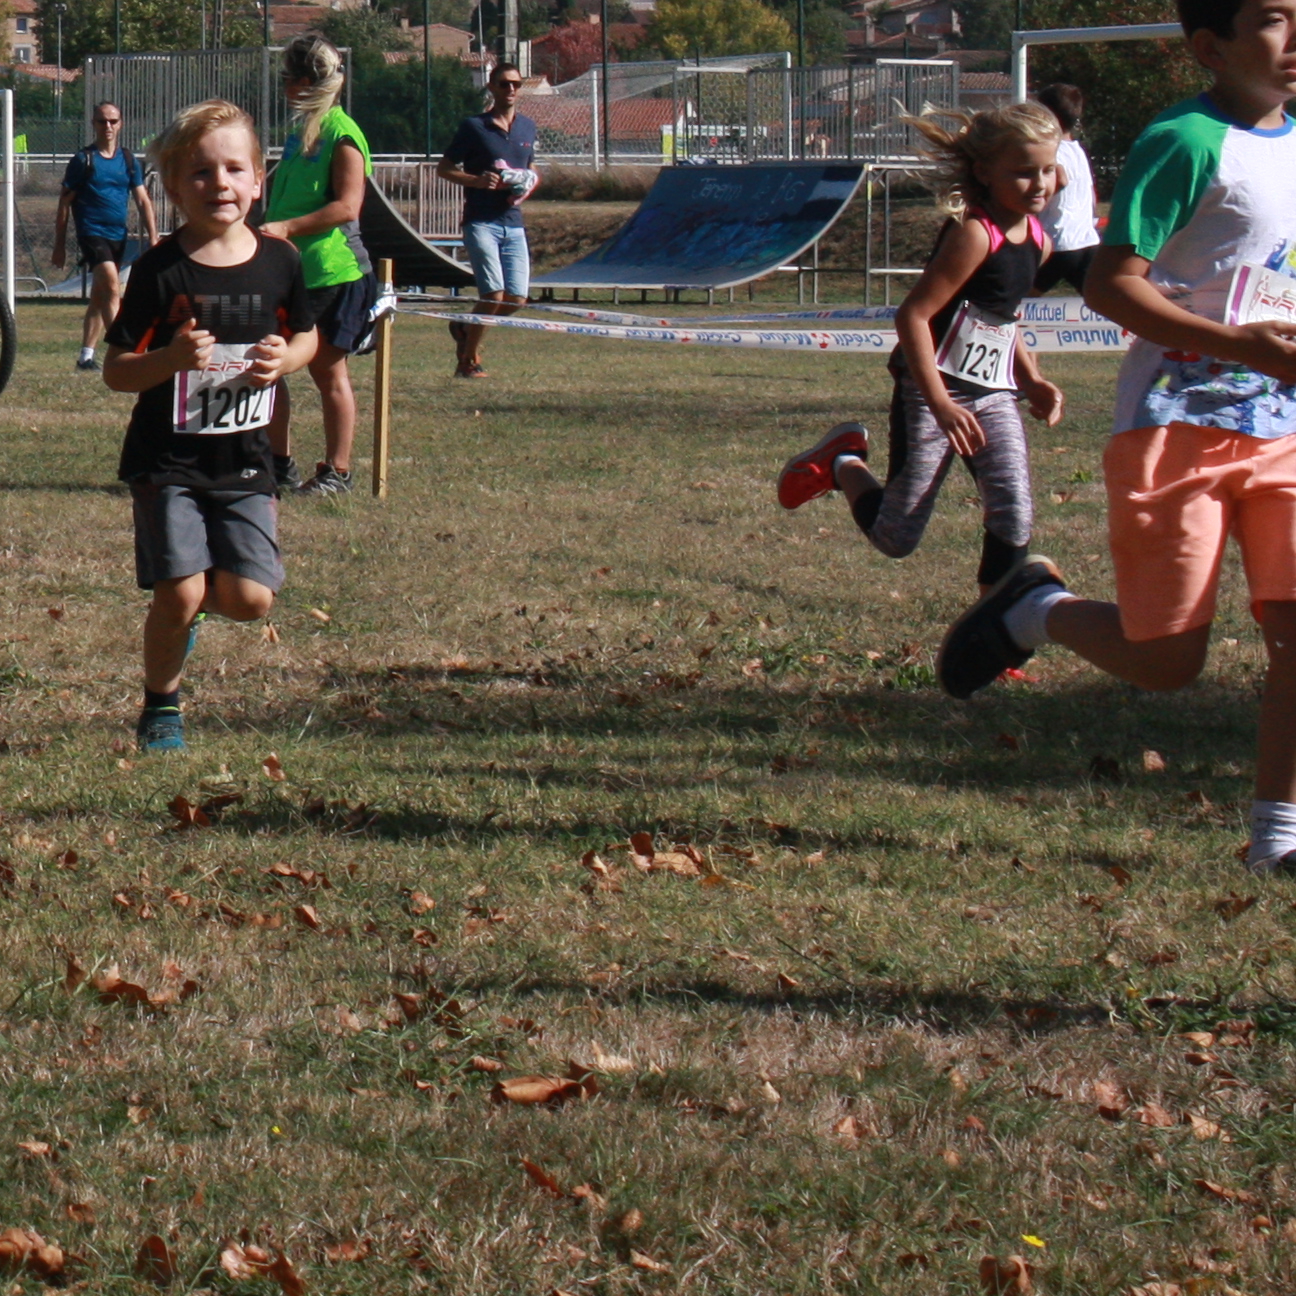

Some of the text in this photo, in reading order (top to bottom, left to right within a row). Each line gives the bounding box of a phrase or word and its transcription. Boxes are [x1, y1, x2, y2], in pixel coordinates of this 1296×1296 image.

[1023, 302, 1067, 322] Mutuel
[758, 331, 812, 345] Mutuel
[831, 332, 884, 348] Crédit
[1056, 328, 1120, 347] Mutuel
[958, 341, 1004, 383] 1231
[197, 385, 264, 429] 1202
